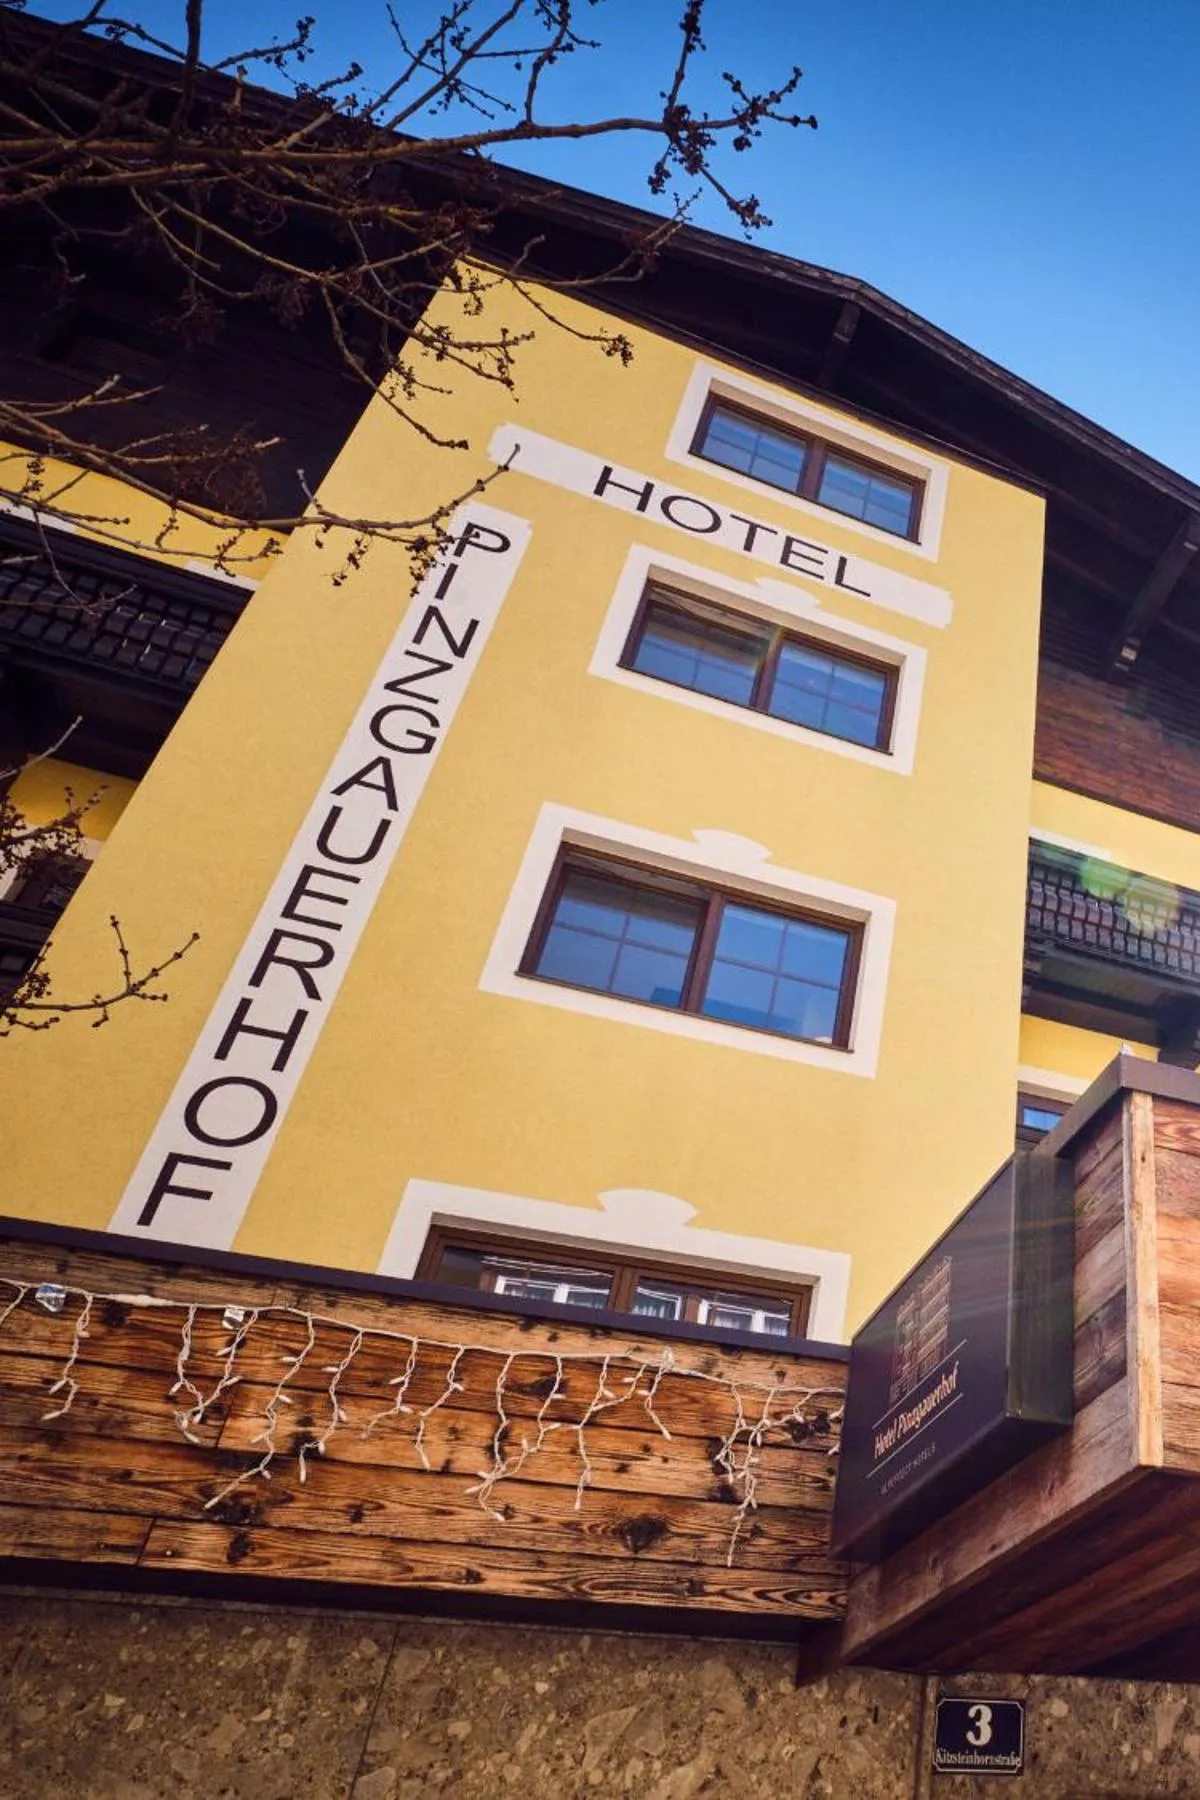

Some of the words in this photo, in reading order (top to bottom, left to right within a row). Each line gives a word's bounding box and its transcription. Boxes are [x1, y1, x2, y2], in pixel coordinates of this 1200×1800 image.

[593, 465, 871, 598] HOTEL
[137, 522, 511, 1227] PINZGAUERHOF
[874, 1416, 897, 1460] Hotel
[966, 1704, 993, 1746] 3
